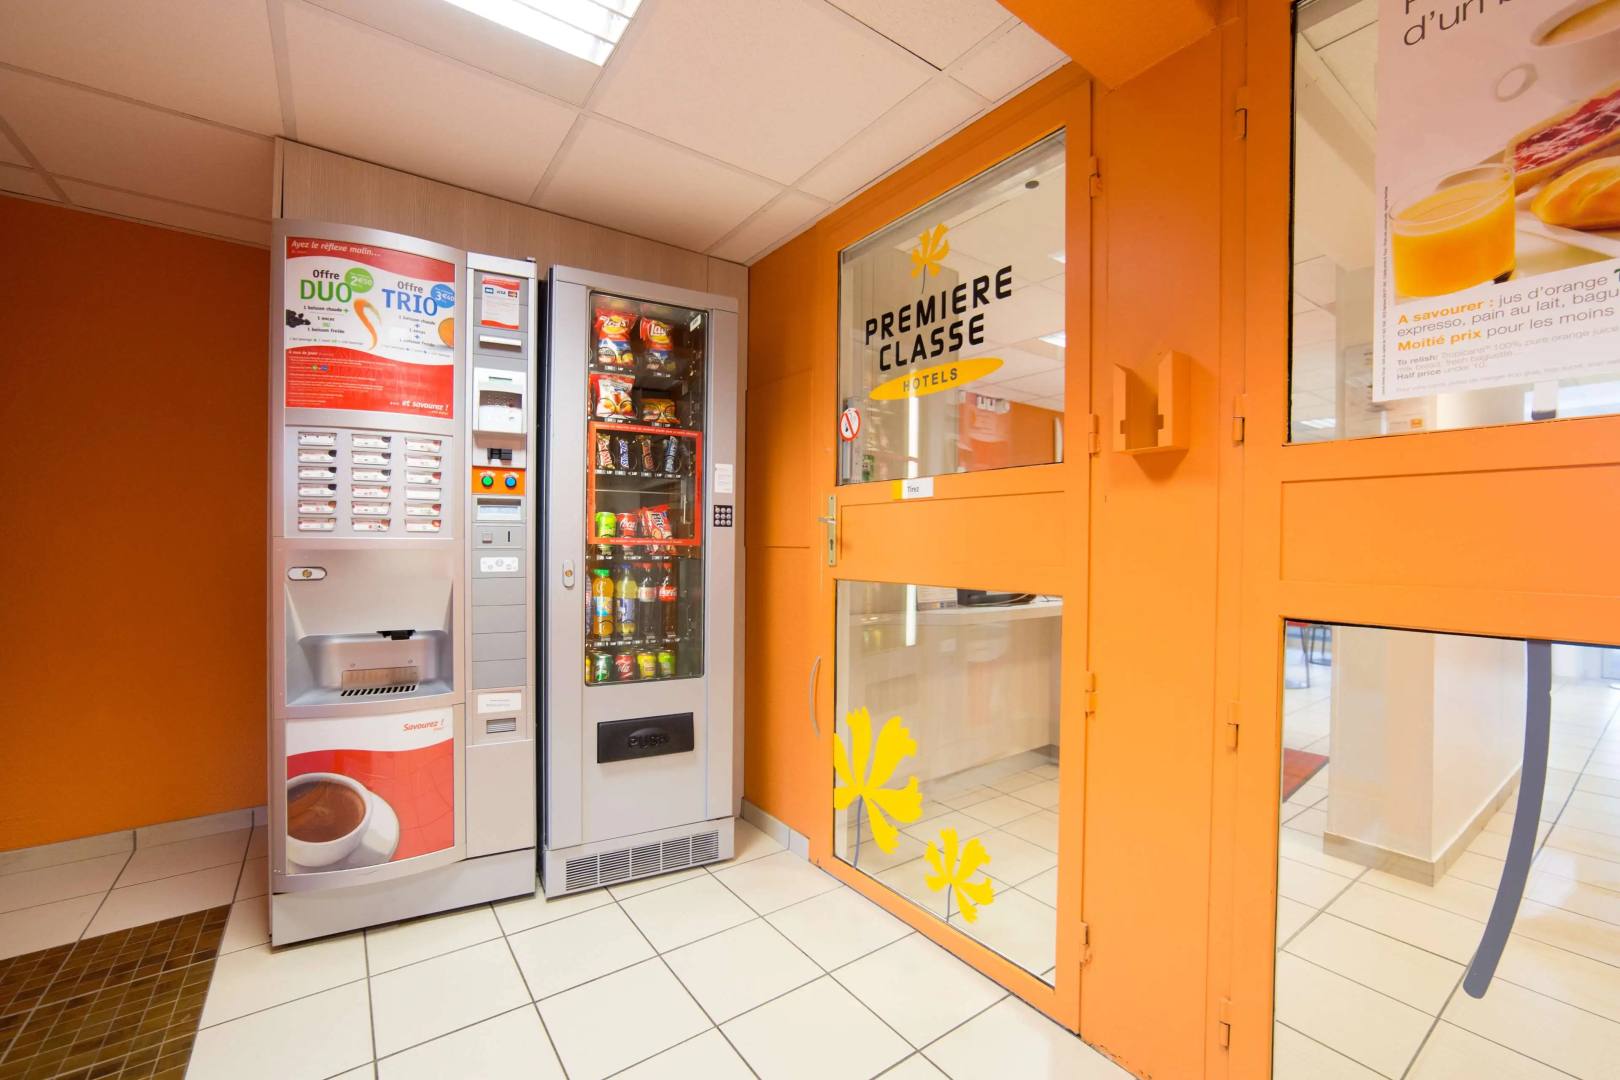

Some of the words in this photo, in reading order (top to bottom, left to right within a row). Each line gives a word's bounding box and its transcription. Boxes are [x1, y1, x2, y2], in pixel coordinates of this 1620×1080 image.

[291, 240, 309, 249] Ayez
[320, 242, 348, 251] réflexe
[313, 269, 340, 280] Offre
[397, 280, 424, 293] Offre
[300, 279, 352, 303] DUO
[382, 288, 438, 316] TRIO
[1398, 314, 1409, 325] A
[1413, 301, 1484, 322] savourer
[1498, 293, 1522, 308] jus
[1528, 276, 1608, 299] d'orange
[866, 264, 1012, 346] PREMIERE
[1397, 318, 1466, 337] expresso,
[1472, 310, 1504, 326] pain
[1510, 305, 1530, 316] au
[1536, 298, 1565, 311] lait,
[1398, 334, 1445, 352] Moitié
[1450, 330, 1482, 345] prix
[1487, 322, 1524, 338] pour
[1530, 318, 1553, 329] les
[1560, 307, 1615, 324] moins
[879, 313, 984, 372] CLASSE
[1410, 354, 1438, 364] relish:
[1525, 337, 1548, 346] pure
[1551, 330, 1589, 342] orange
[1592, 326, 1619, 336] juice
[903, 368, 958, 392] HOTELS
[1397, 371, 1416, 380] Half
[1417, 369, 1441, 378] price
[412, 402, 444, 410] savourez
[403, 721, 438, 731] Savourez
[627, 734, 669, 749] PUSH
